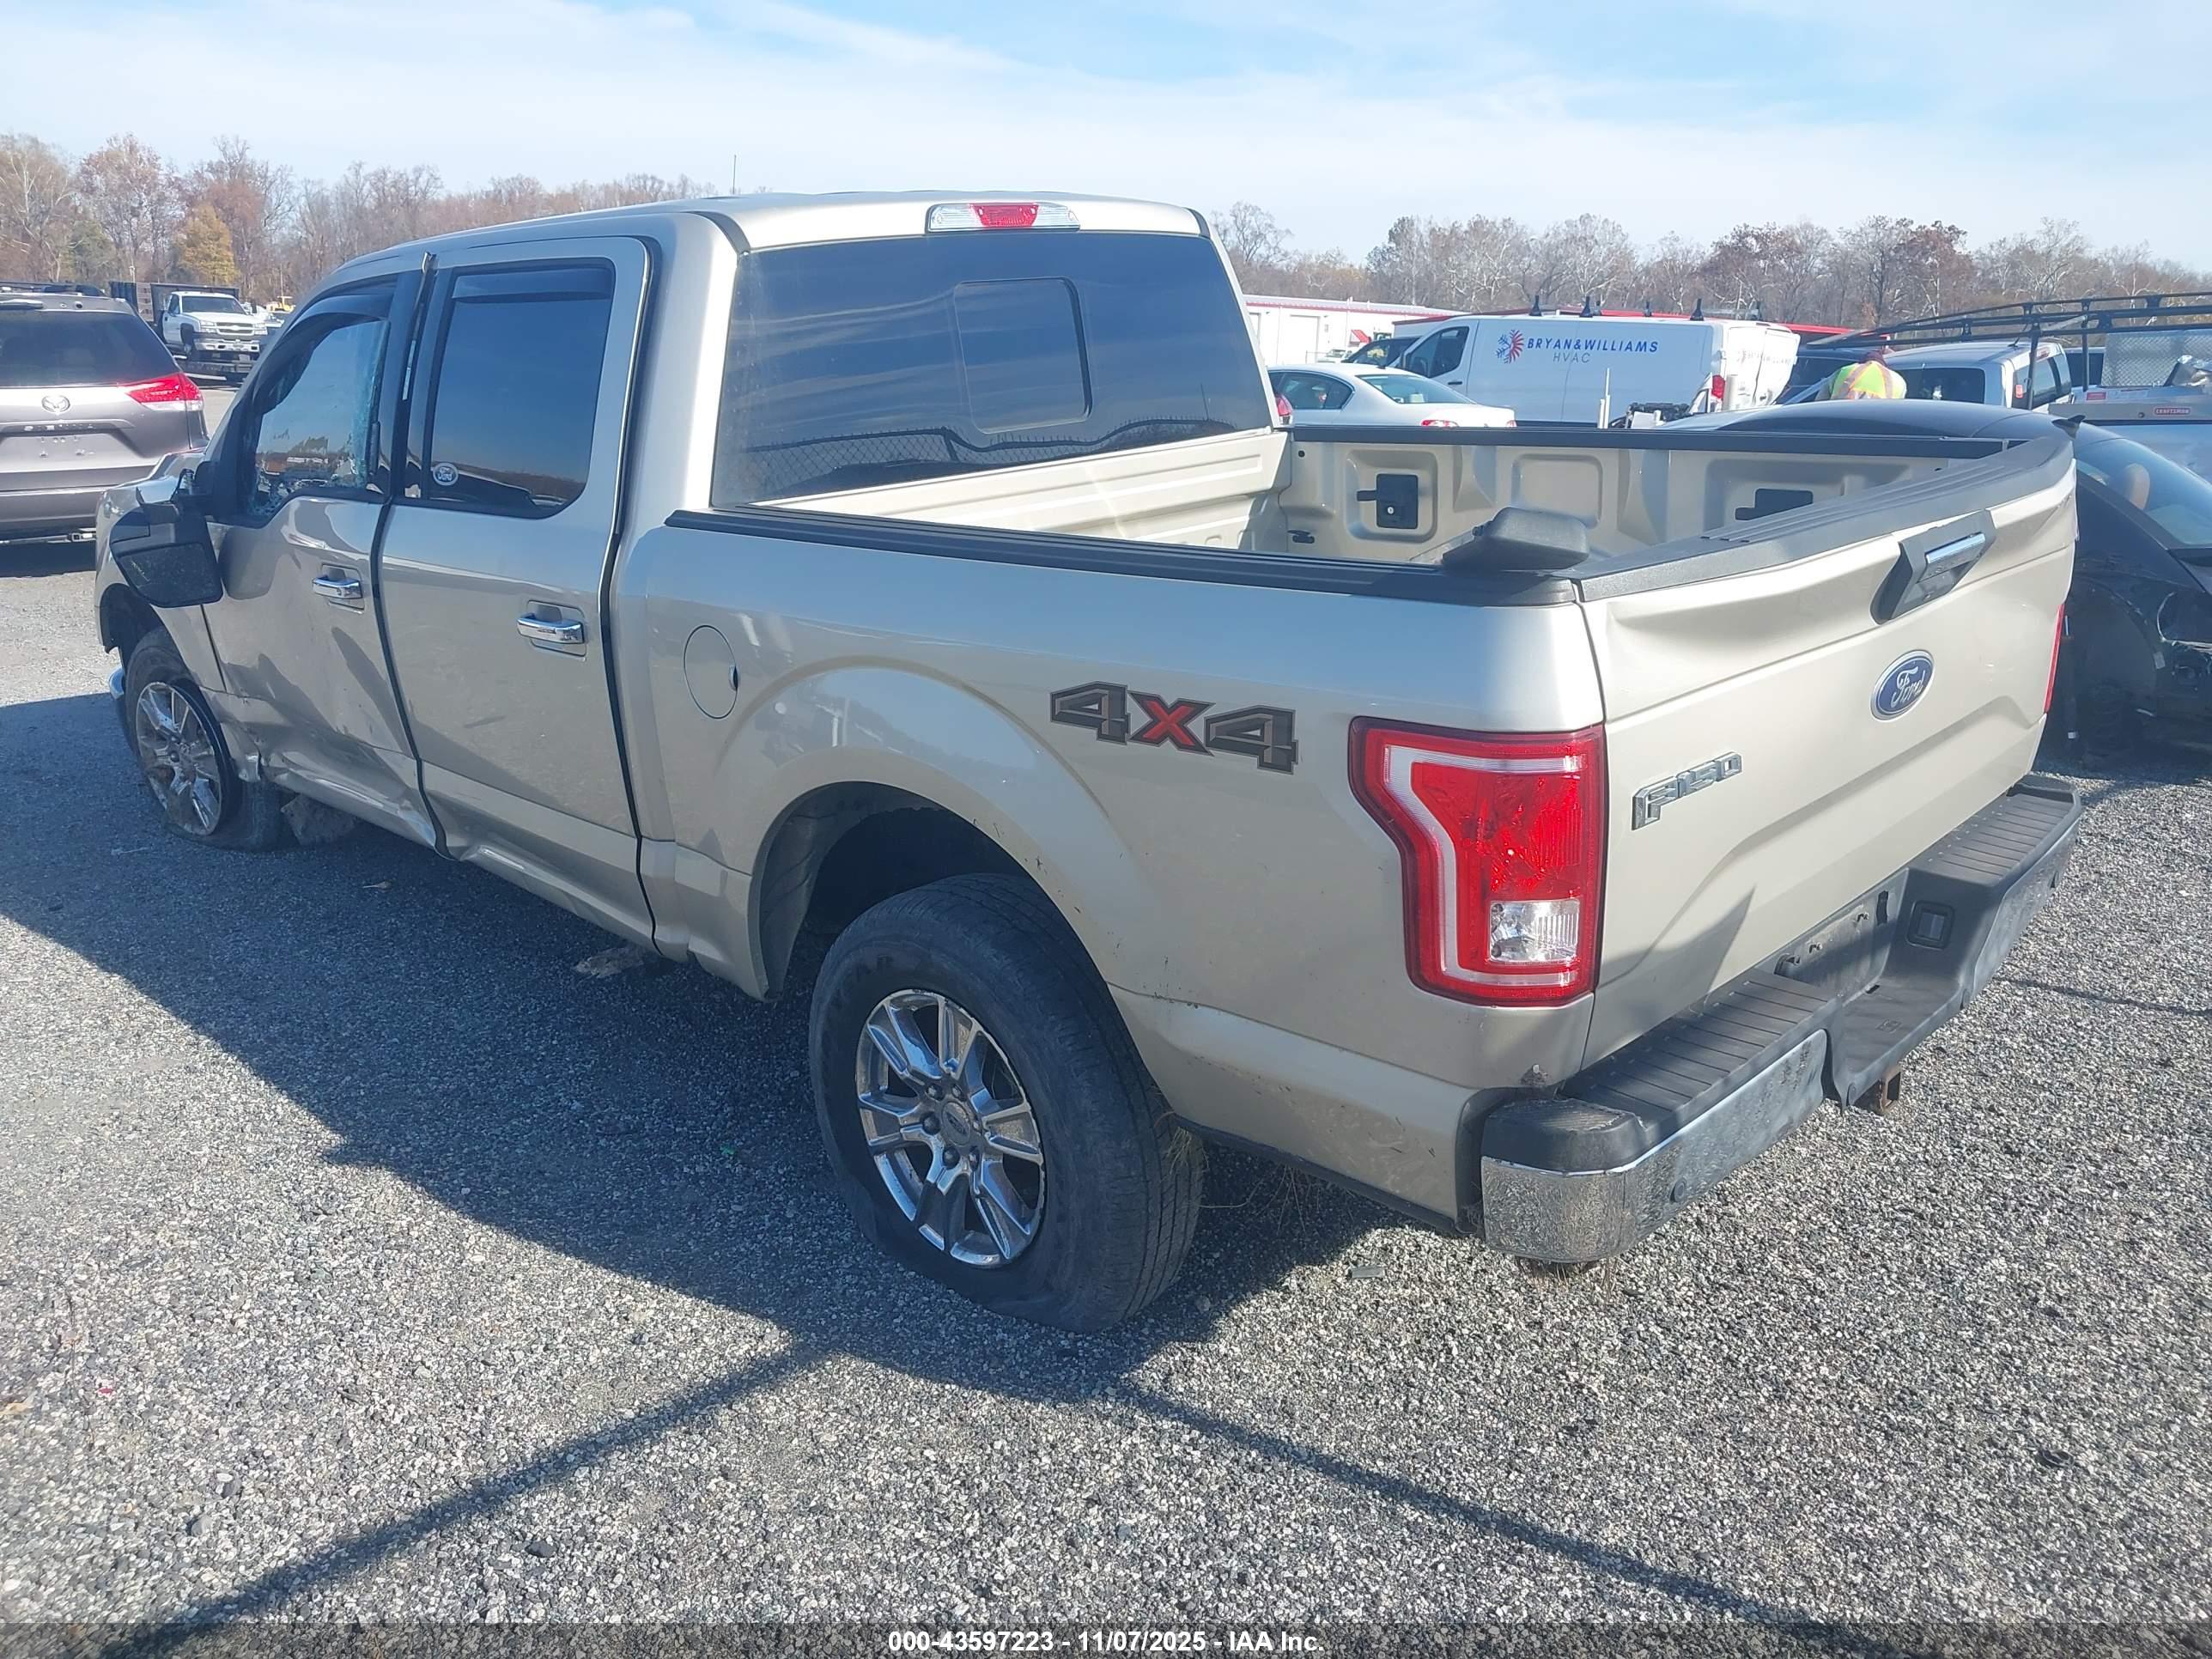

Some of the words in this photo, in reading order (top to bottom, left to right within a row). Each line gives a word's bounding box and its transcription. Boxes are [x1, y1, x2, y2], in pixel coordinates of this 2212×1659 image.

[1527, 337, 1659, 353] BRYAN&WILLIAMS
[1553, 352, 1591, 363] HVAC
[1890, 665, 1926, 708] Ford
